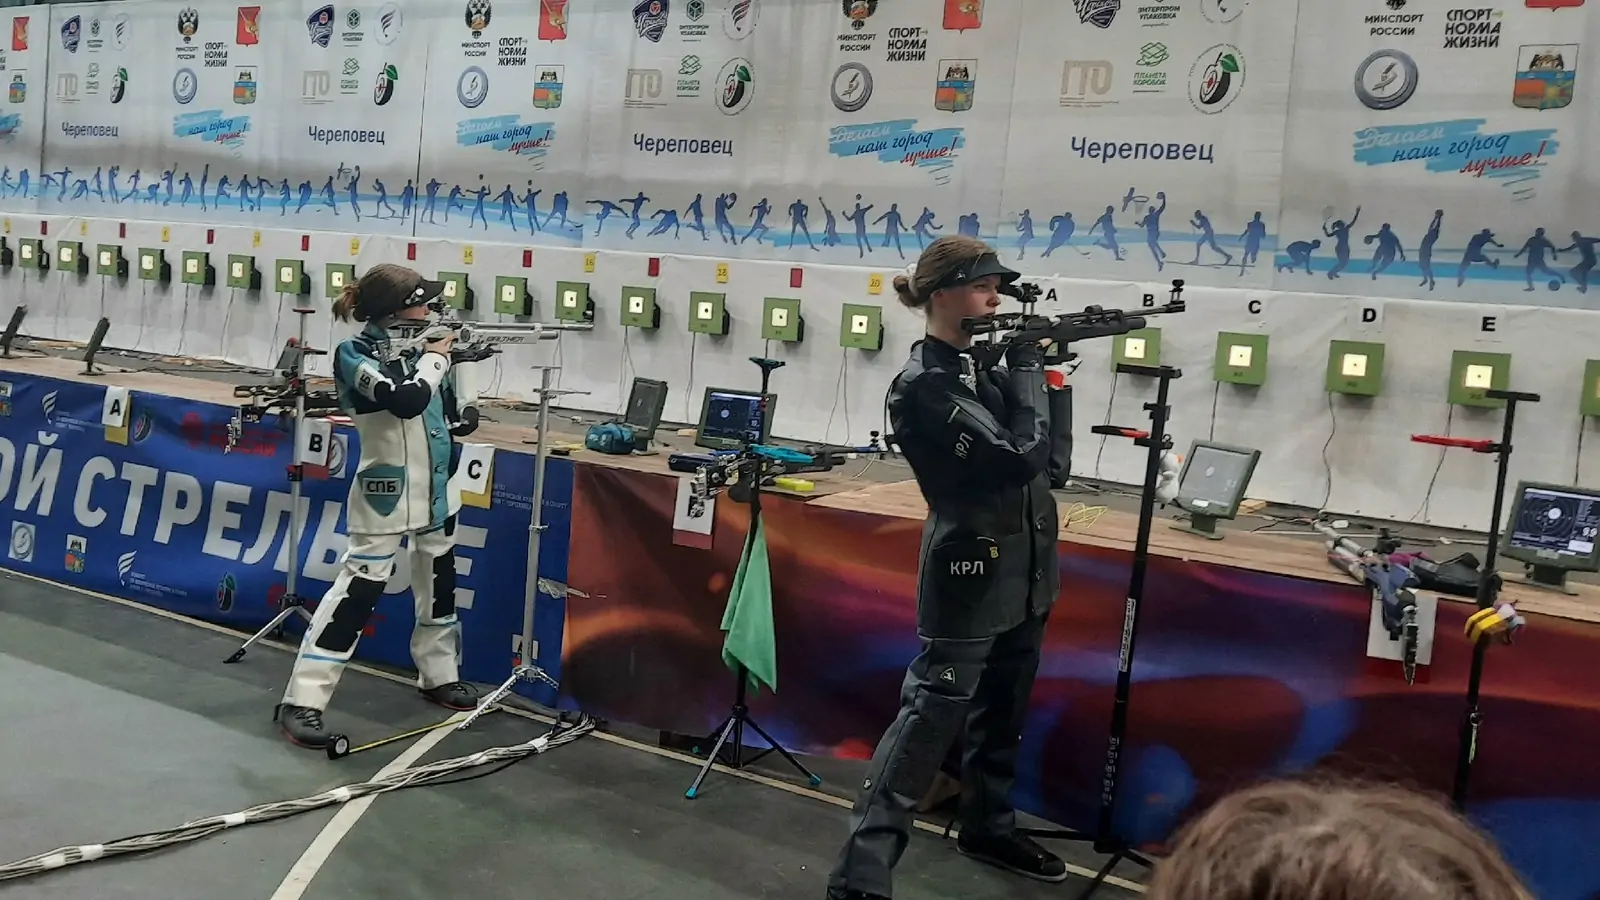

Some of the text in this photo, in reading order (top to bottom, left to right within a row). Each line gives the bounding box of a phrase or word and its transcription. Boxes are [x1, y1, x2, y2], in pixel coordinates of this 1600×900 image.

[1365, 14, 1424, 24] МИНСПОРТ
[1445, 21, 1502, 35] НОРМА
[837, 33, 876, 41] МИНСПОРТ
[1370, 27, 1416, 37] РОССИИ
[887, 39, 927, 50] НОРМА
[1443, 35, 1500, 48] ЖИЗНИ
[498, 47, 527, 56] НОРМА
[886, 50, 926, 62] ЖИЗНИ
[498, 57, 527, 66] ЖИЗНИ
[61, 121, 119, 140] Череповец
[308, 126, 386, 146] Череповец
[633, 133, 733, 157] Череповец
[856, 131, 934, 155] наш город
[900, 137, 958, 167] лучше!
[1071, 137, 1214, 163] Череповец
[1391, 134, 1510, 162] наш город
[1460, 141, 1547, 178] лучше!
[1045, 288, 1497, 332] A B C D E
[109, 398, 121, 416] A
[308, 433, 323, 453] B
[467, 460, 483, 480] C
[367, 480, 396, 493] СПБ
[950, 561, 984, 576] КРЛ
